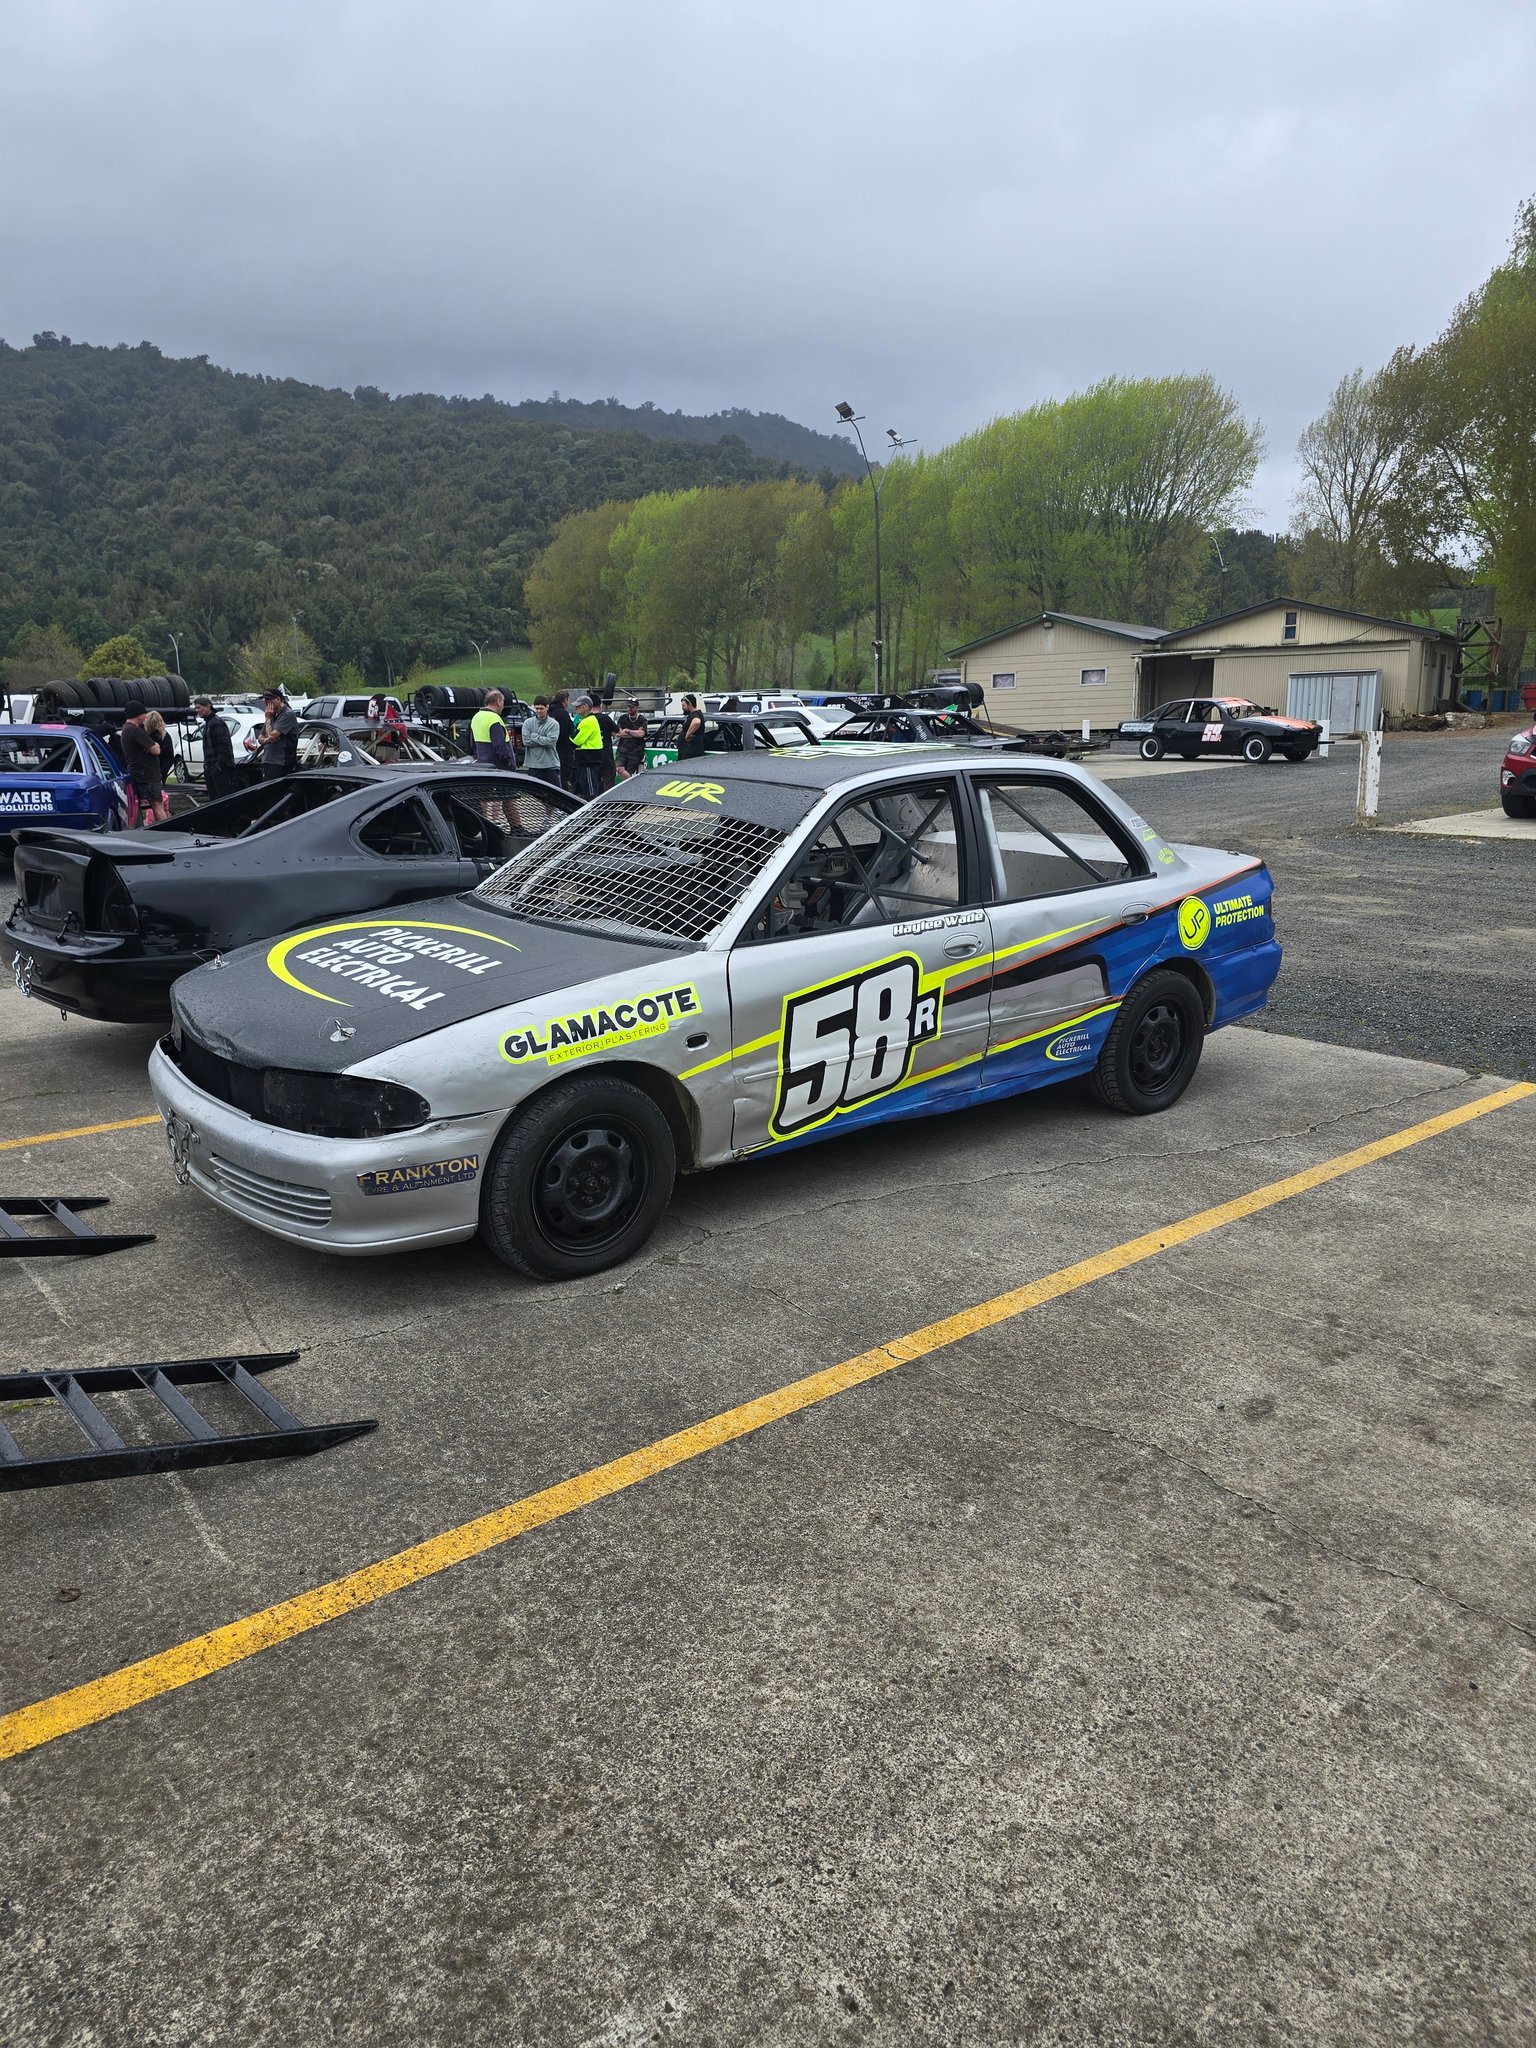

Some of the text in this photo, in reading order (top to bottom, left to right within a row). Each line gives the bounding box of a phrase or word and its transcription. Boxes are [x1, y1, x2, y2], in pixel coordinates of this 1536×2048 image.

[0, 792, 52, 804] WATER
[0, 804, 54, 812] SOLUTIONS
[1213, 895, 1253, 915] ULTIMATE
[893, 912, 985, 936] Haylee Wade
[1215, 905, 1264, 928] PROTECTION
[332, 938, 414, 965] AUTO
[368, 927, 502, 975] PICKERILL
[296, 947, 446, 1011] ELECTRICAL
[504, 987, 697, 1059] GLAMACOTE
[1056, 1042, 1076, 1050] AUTO
[1059, 1033, 1090, 1044] PICKERILL
[1055, 1044, 1092, 1056] ELECTRICAL
[457, 1172, 475, 1181] LTD
